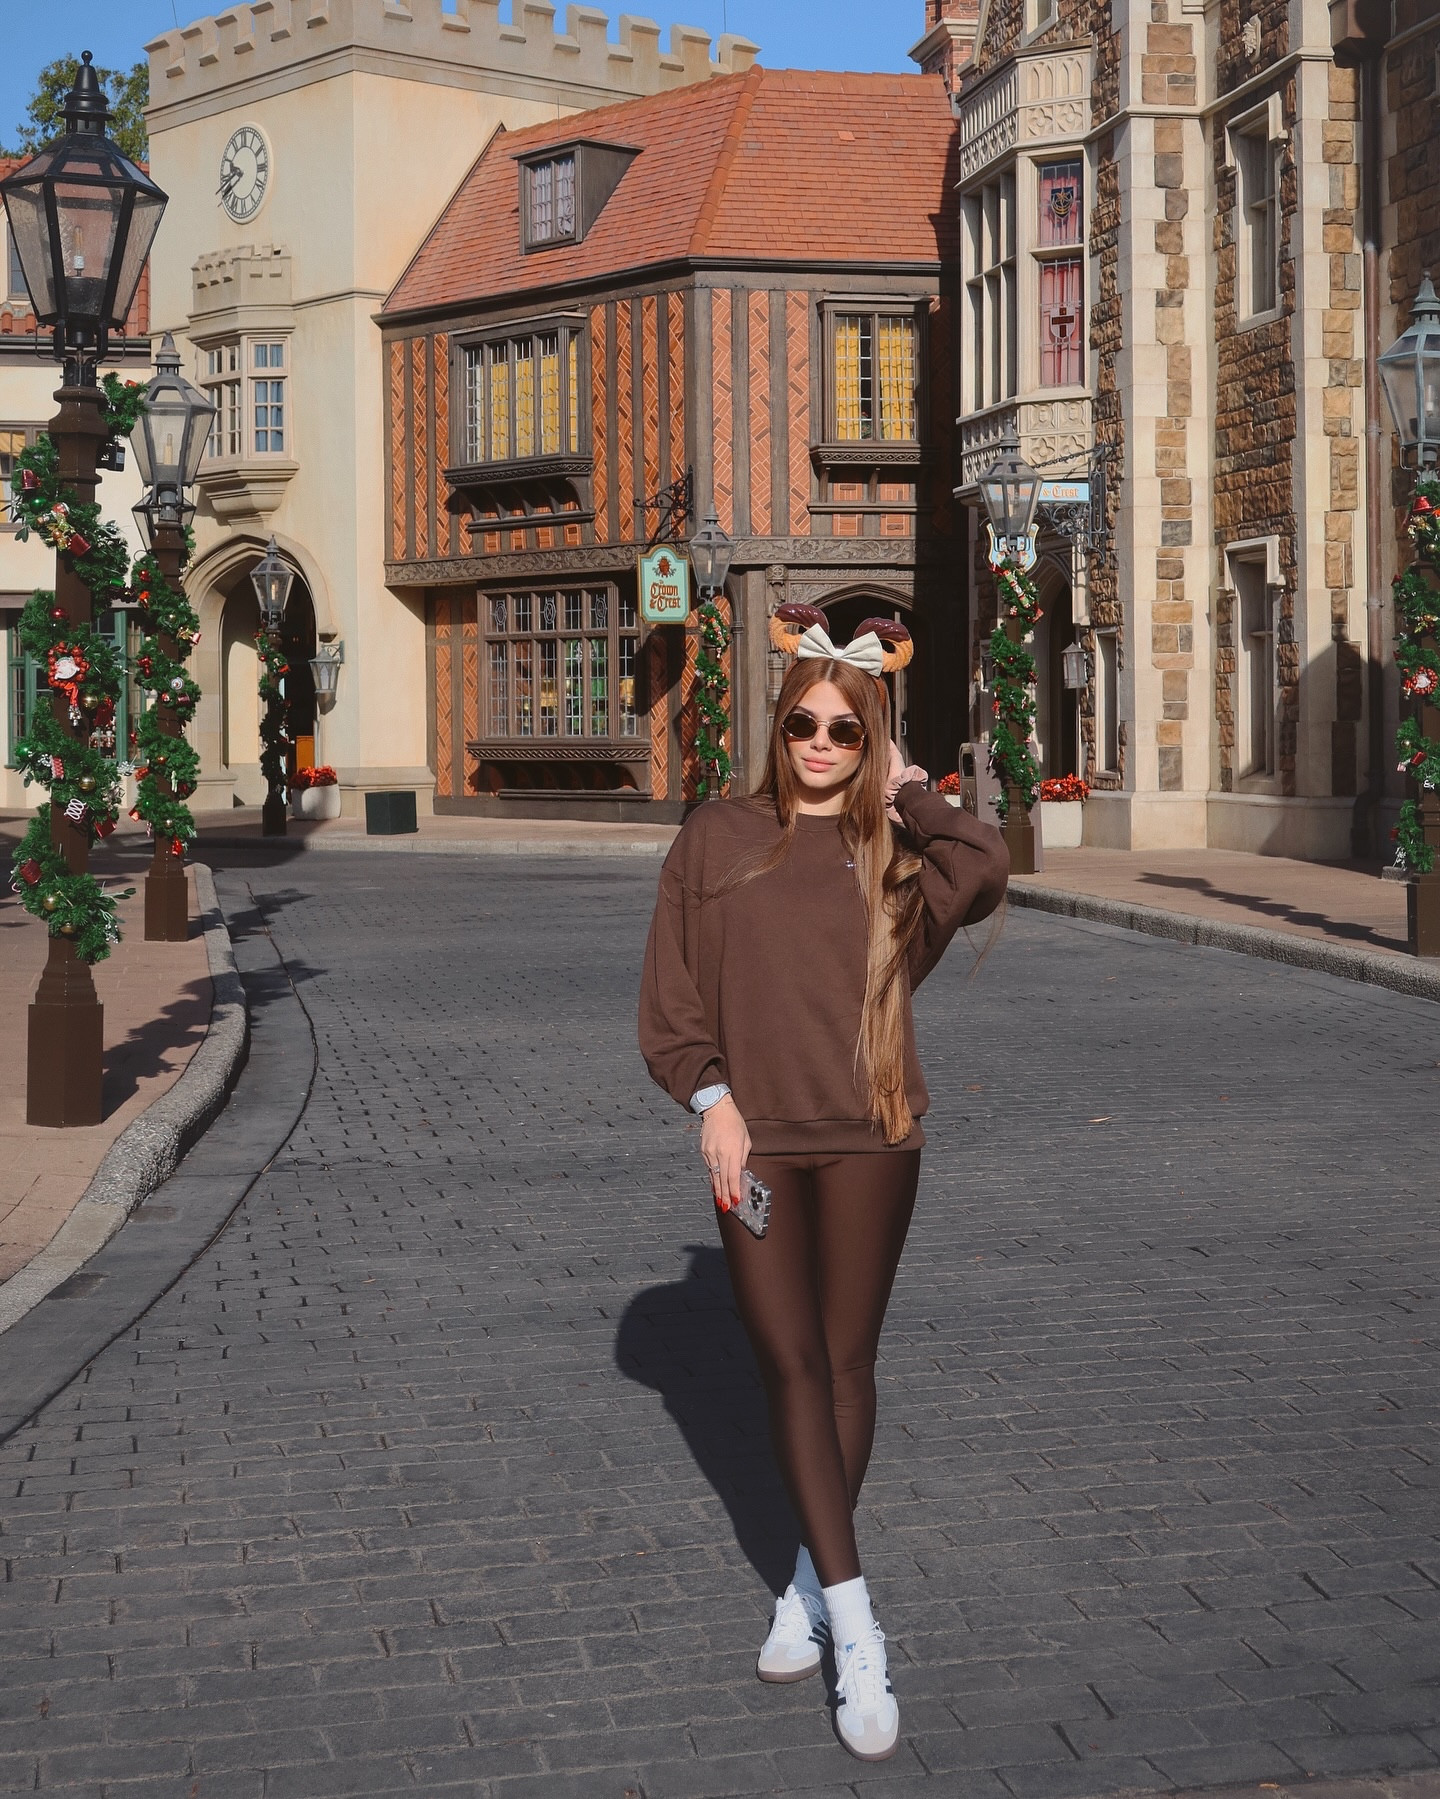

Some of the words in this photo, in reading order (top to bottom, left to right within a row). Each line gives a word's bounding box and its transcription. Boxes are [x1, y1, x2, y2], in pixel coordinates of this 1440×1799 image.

[1042, 487, 1050, 497] &
[1052, 485, 1079, 499] Crest
[650, 582, 679, 599] Crown
[649, 599, 657, 609] &
[657, 595, 681, 612] Crest
